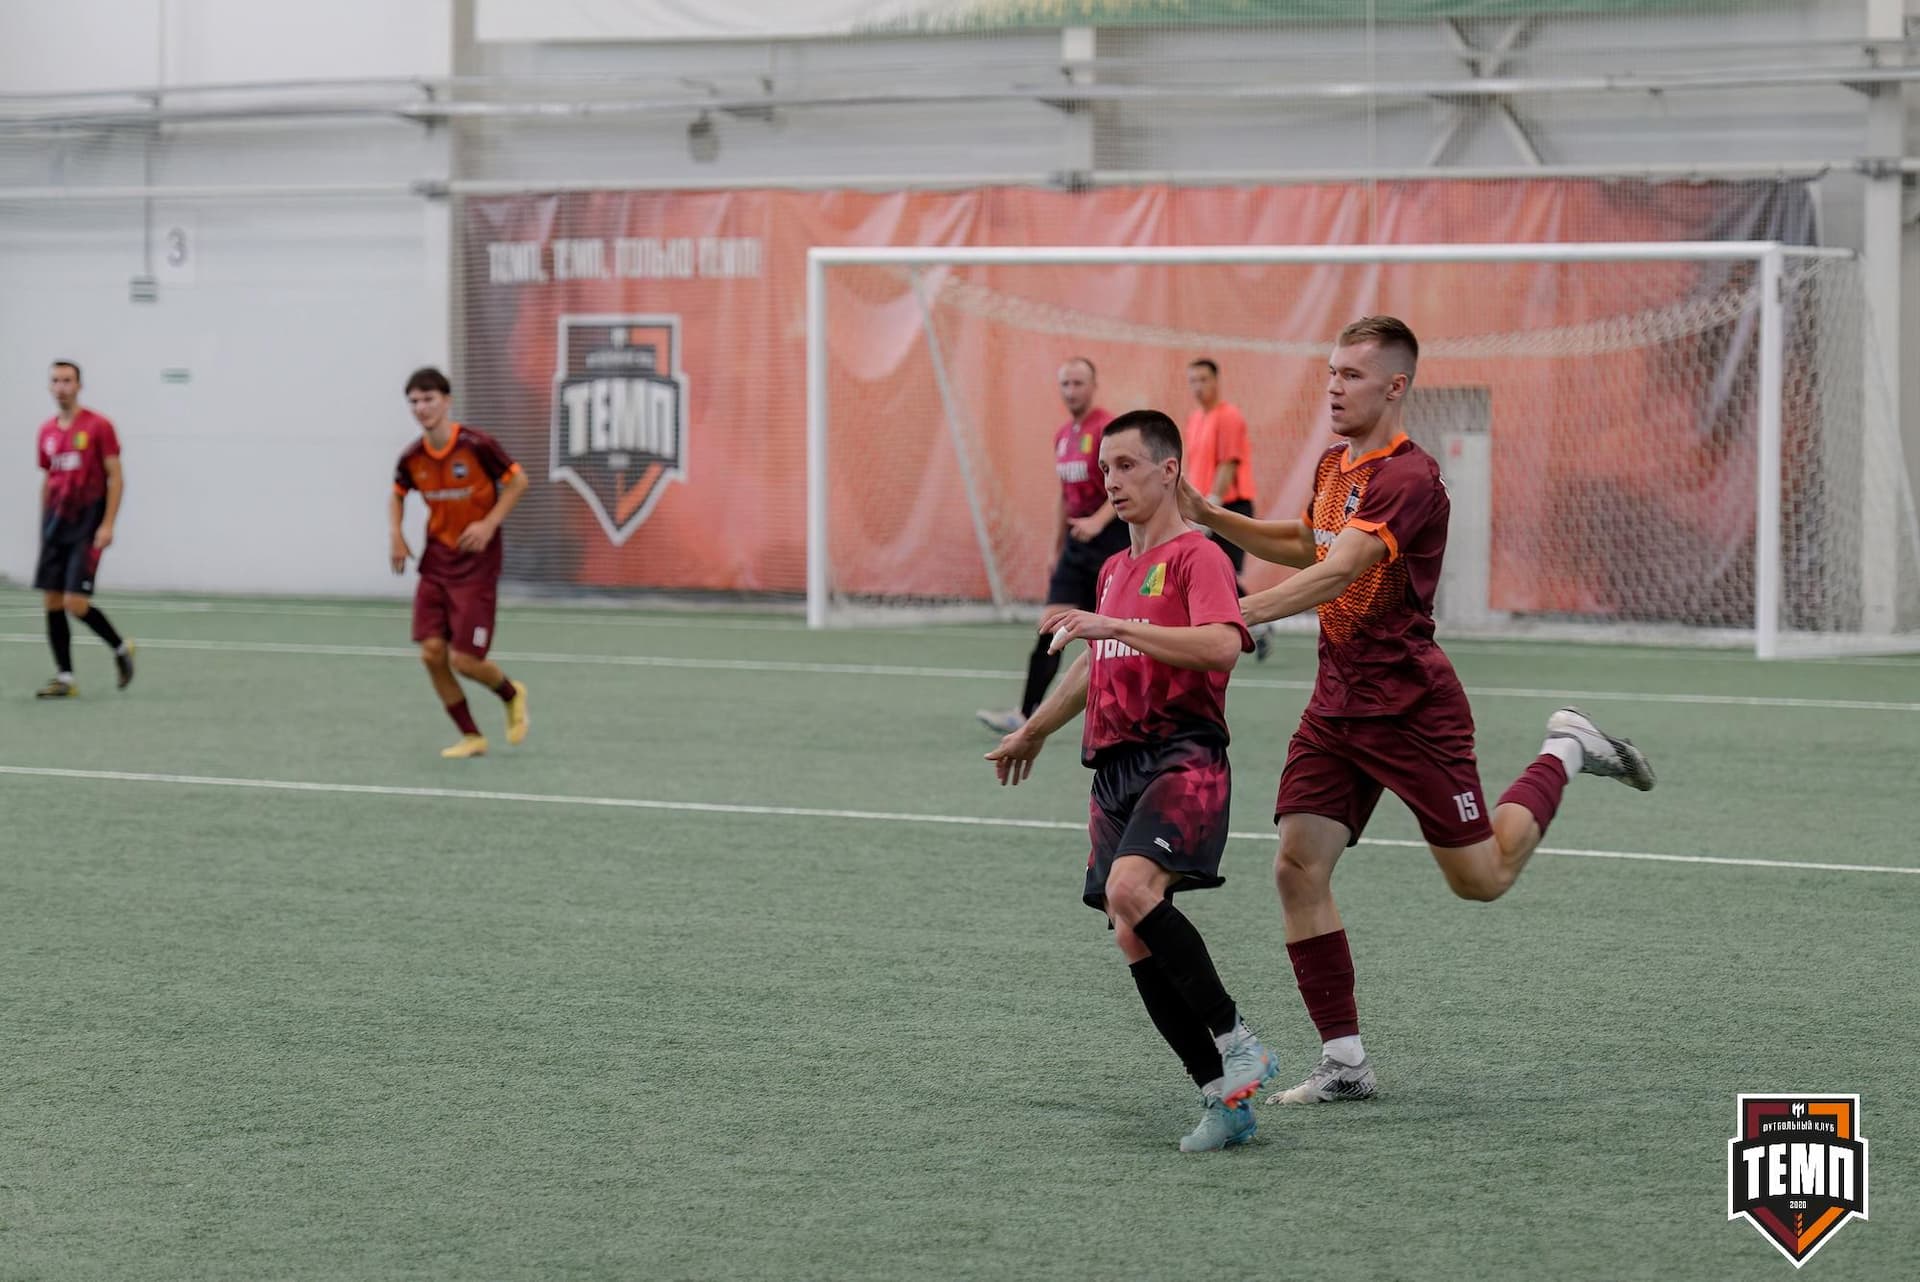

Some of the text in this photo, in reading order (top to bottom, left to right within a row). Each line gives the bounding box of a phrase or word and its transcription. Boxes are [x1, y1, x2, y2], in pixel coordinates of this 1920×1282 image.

[166, 227, 188, 268] 3
[562, 377, 676, 459] ТЕМП
[1452, 791, 1480, 822] 15
